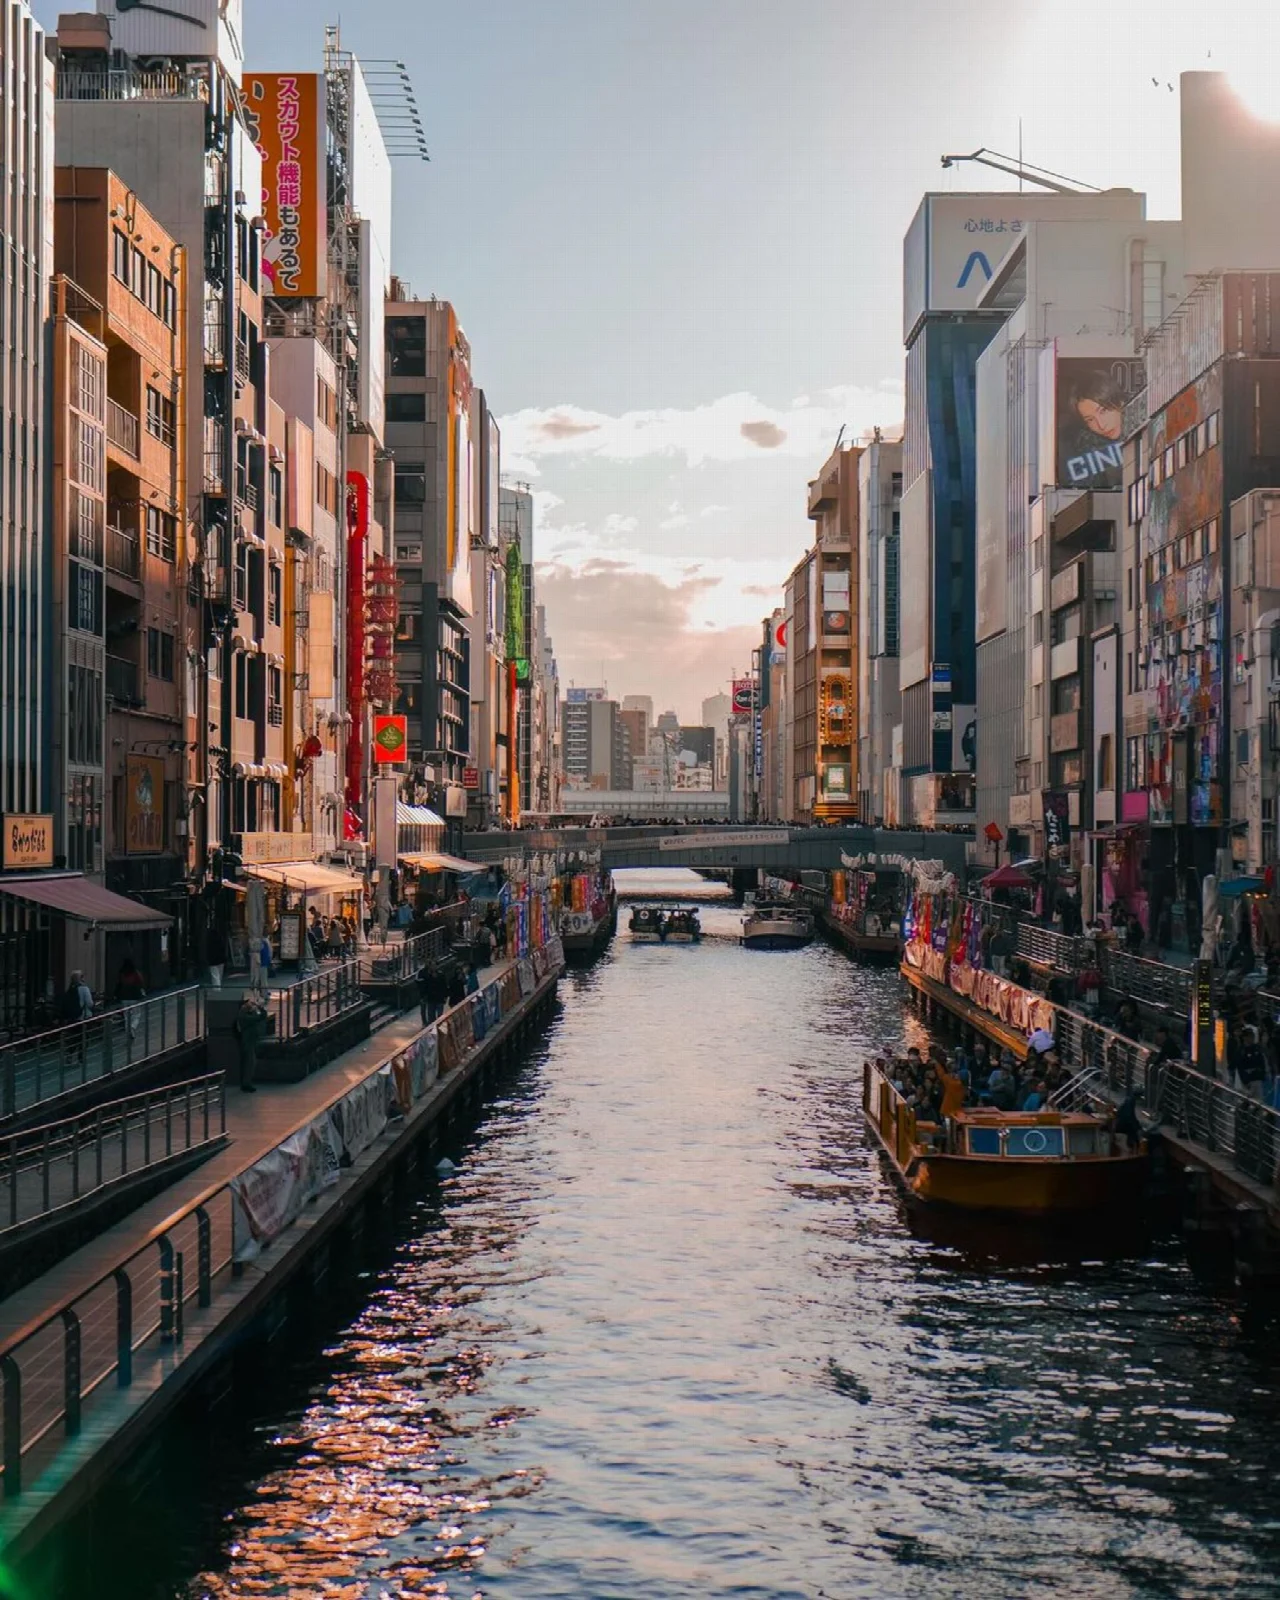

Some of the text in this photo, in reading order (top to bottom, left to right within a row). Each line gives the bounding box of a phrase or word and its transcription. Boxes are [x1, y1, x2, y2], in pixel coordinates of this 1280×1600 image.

[277, 77, 300, 290] スカウト機能もあるで
[964, 218, 1022, 233] 心地よさ
